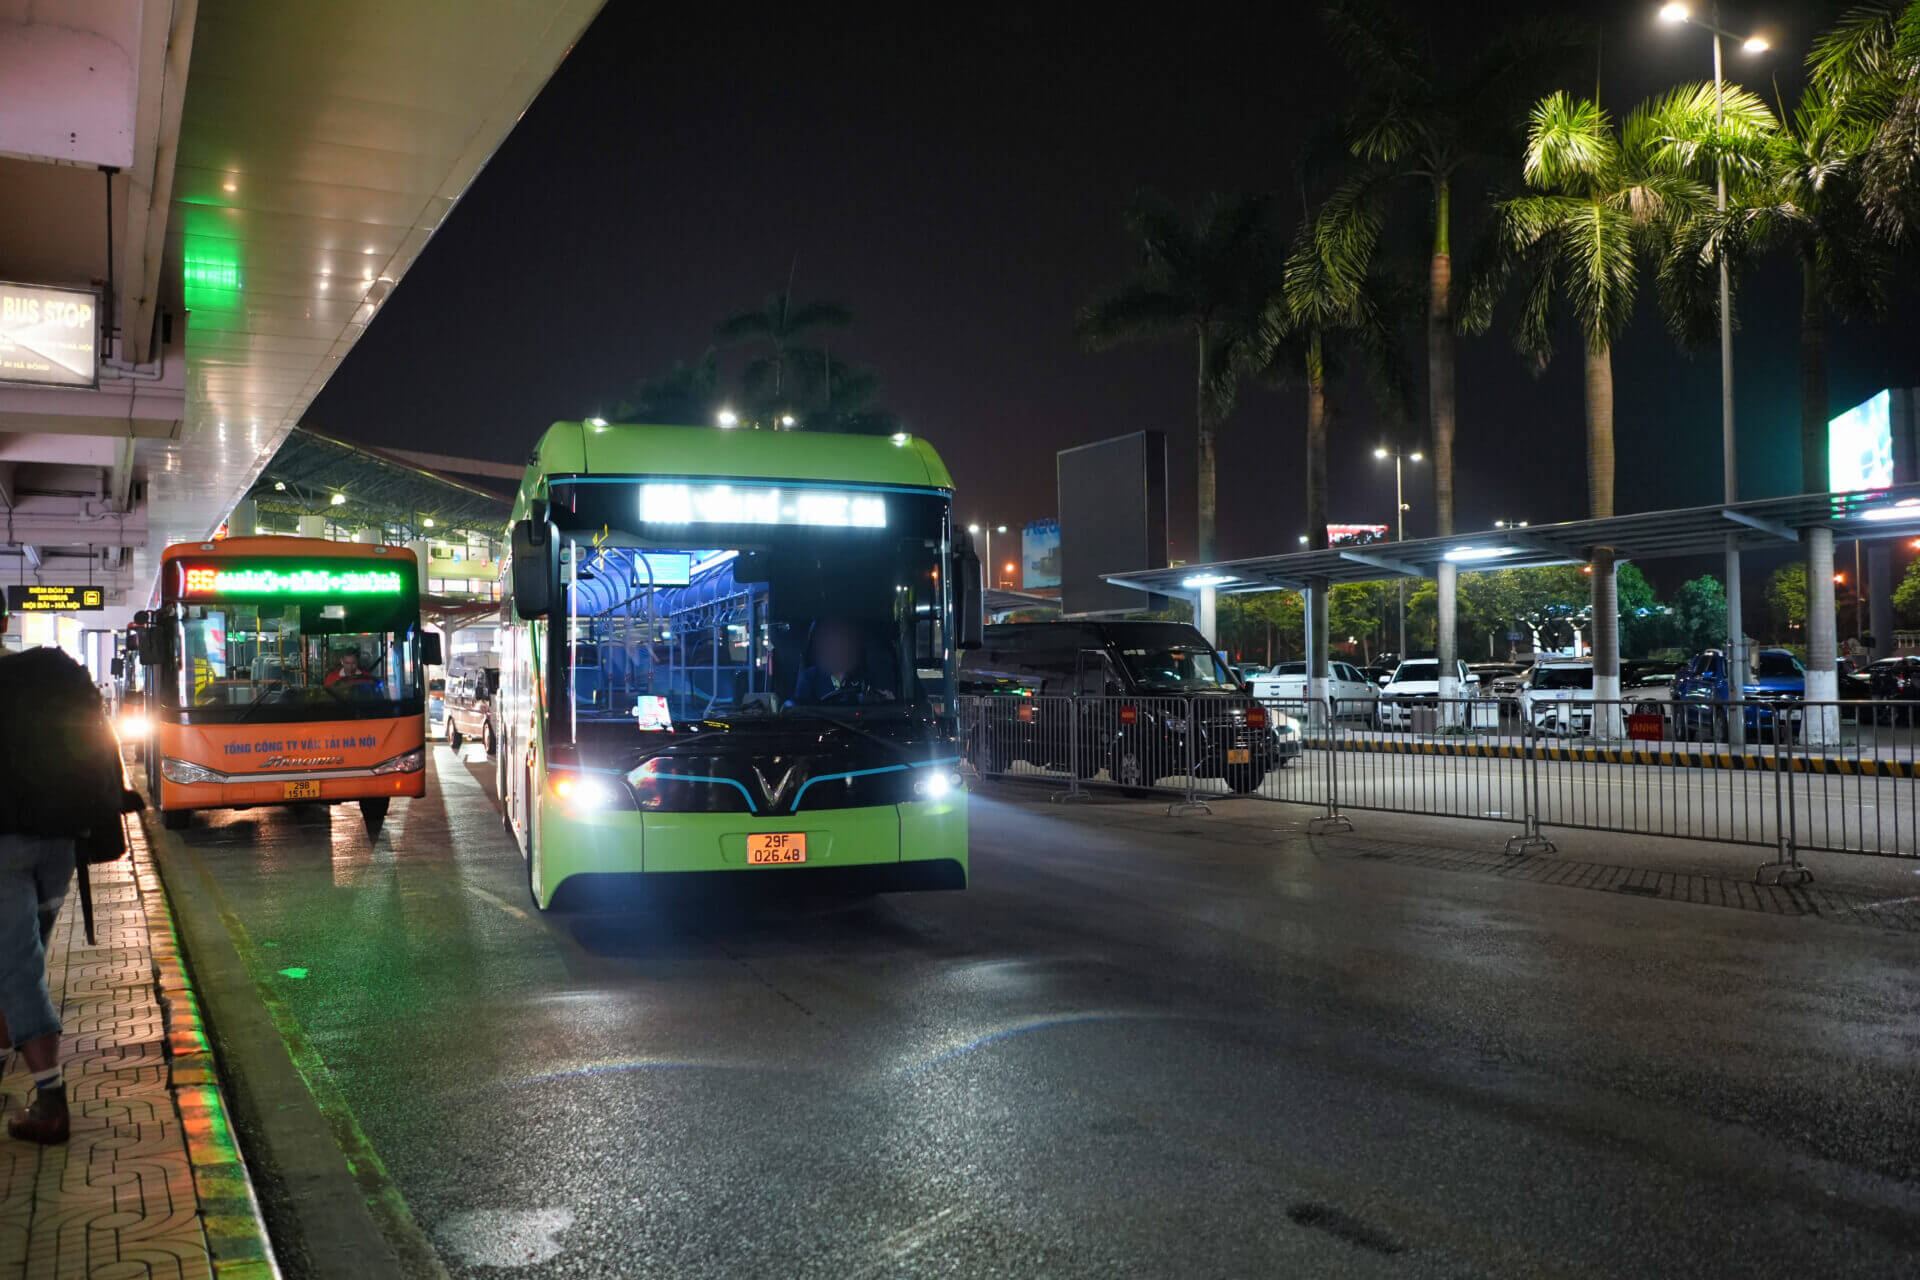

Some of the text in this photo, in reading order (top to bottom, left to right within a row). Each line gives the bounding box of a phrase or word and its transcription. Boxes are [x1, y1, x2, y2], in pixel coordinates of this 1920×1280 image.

[3, 295, 92, 328] BUS STOP
[224, 738, 252, 755] TỔNG
[255, 738, 283, 752] CÔNG
[287, 740, 298, 751] TY
[359, 734, 376, 750] NỘI
[294, 781, 310, 790] 29B
[765, 835, 789, 848] 29F
[754, 848, 800, 863] 026.48
